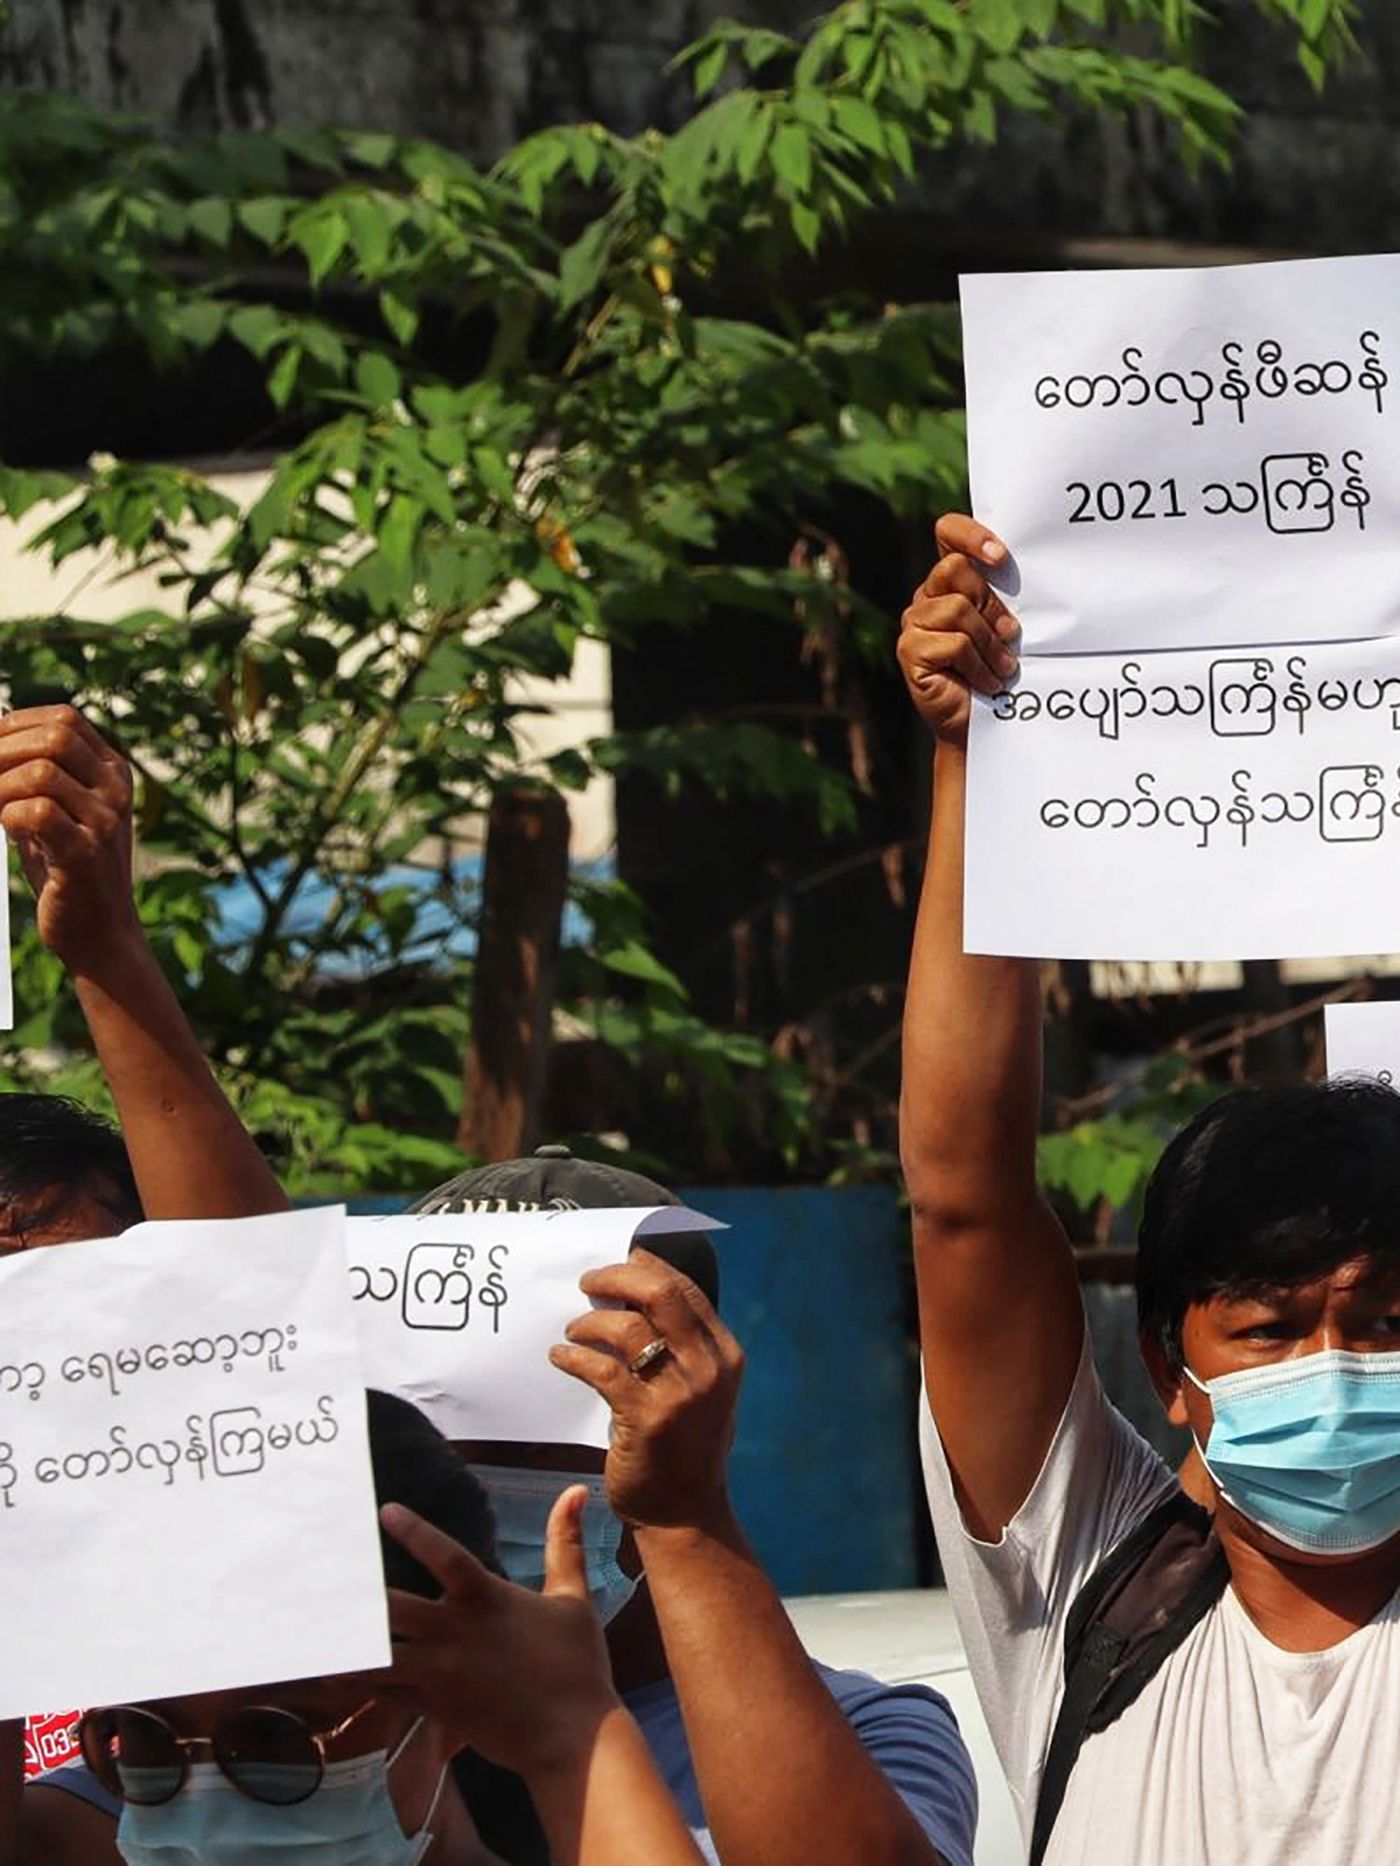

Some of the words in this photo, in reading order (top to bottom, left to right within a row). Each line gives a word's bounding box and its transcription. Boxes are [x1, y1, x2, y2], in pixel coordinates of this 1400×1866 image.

[1034, 330, 1389, 427] တော်လှန်ဖီဆန်
[1065, 477, 1187, 524] 2021
[1201, 449, 1371, 535] သင်္ကြန်
